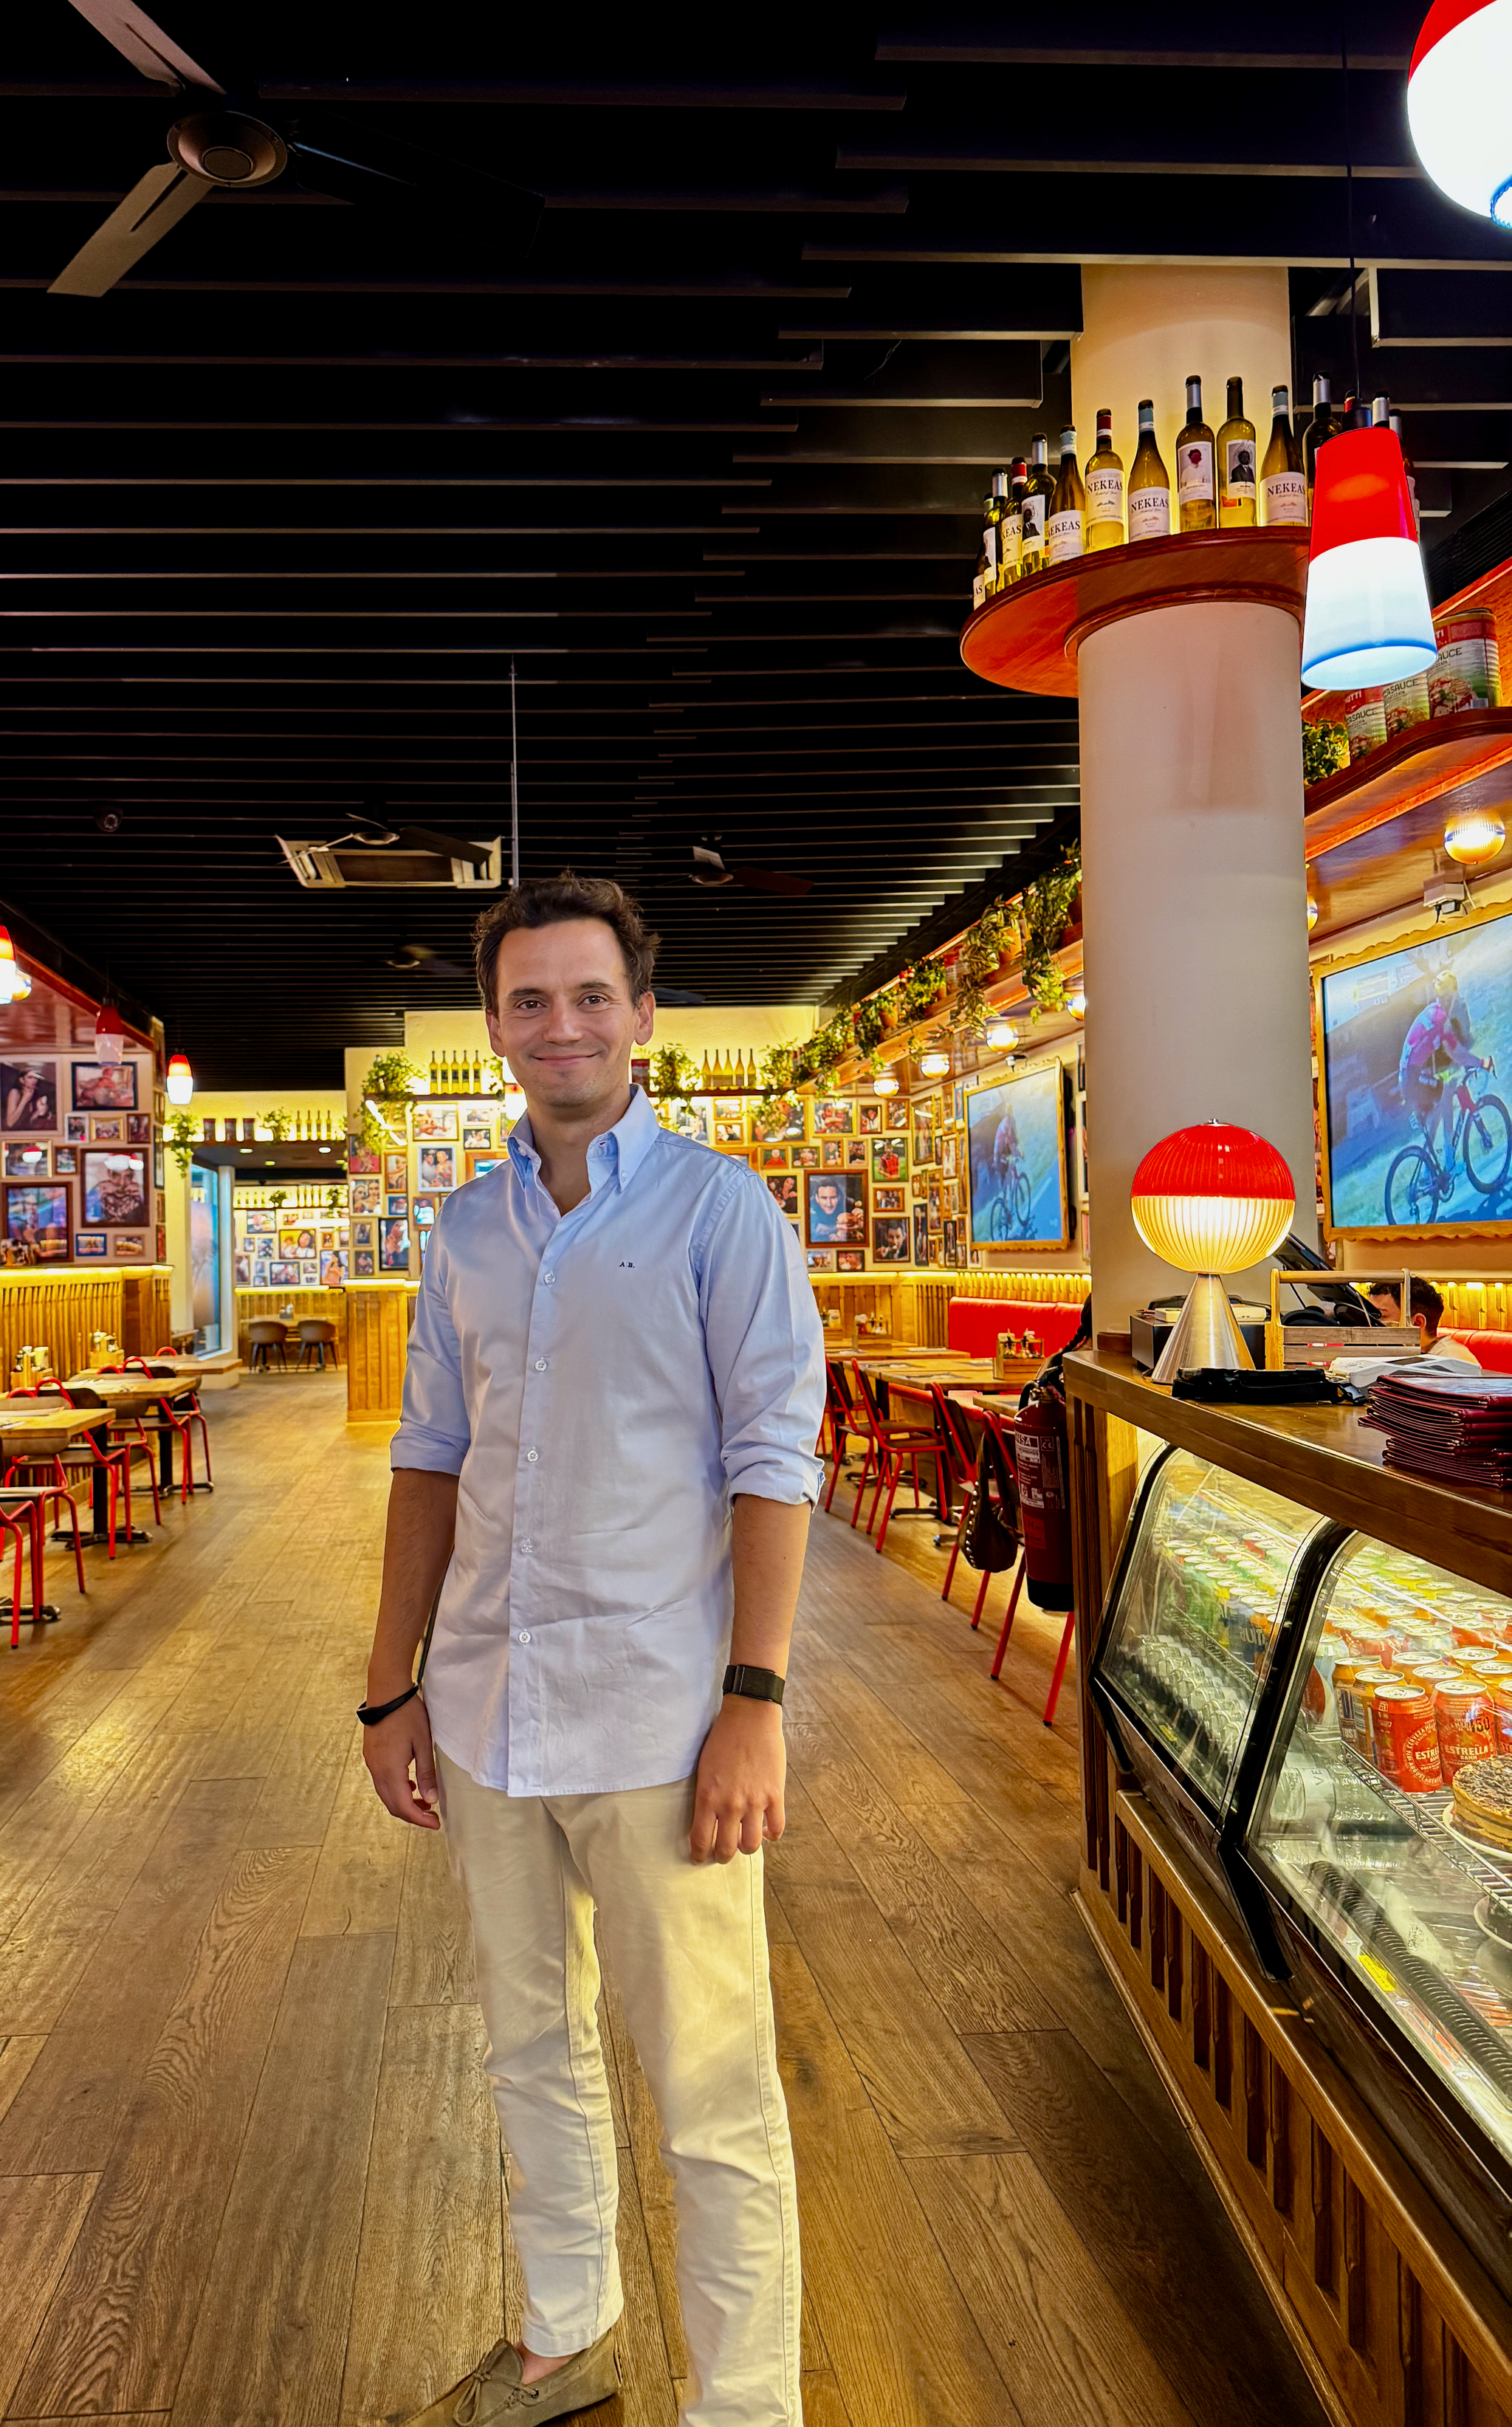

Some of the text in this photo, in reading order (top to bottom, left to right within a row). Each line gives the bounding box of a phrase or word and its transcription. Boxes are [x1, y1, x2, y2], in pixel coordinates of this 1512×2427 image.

[1087, 479, 1123, 494] NEKEAS
[1131, 498, 1169, 513] NEKEAS
[1344, 690, 1362, 703] UTTI
[1415, 1747, 1438, 1760] ESTRE
[1444, 1744, 1489, 1756] ESTRELLA
